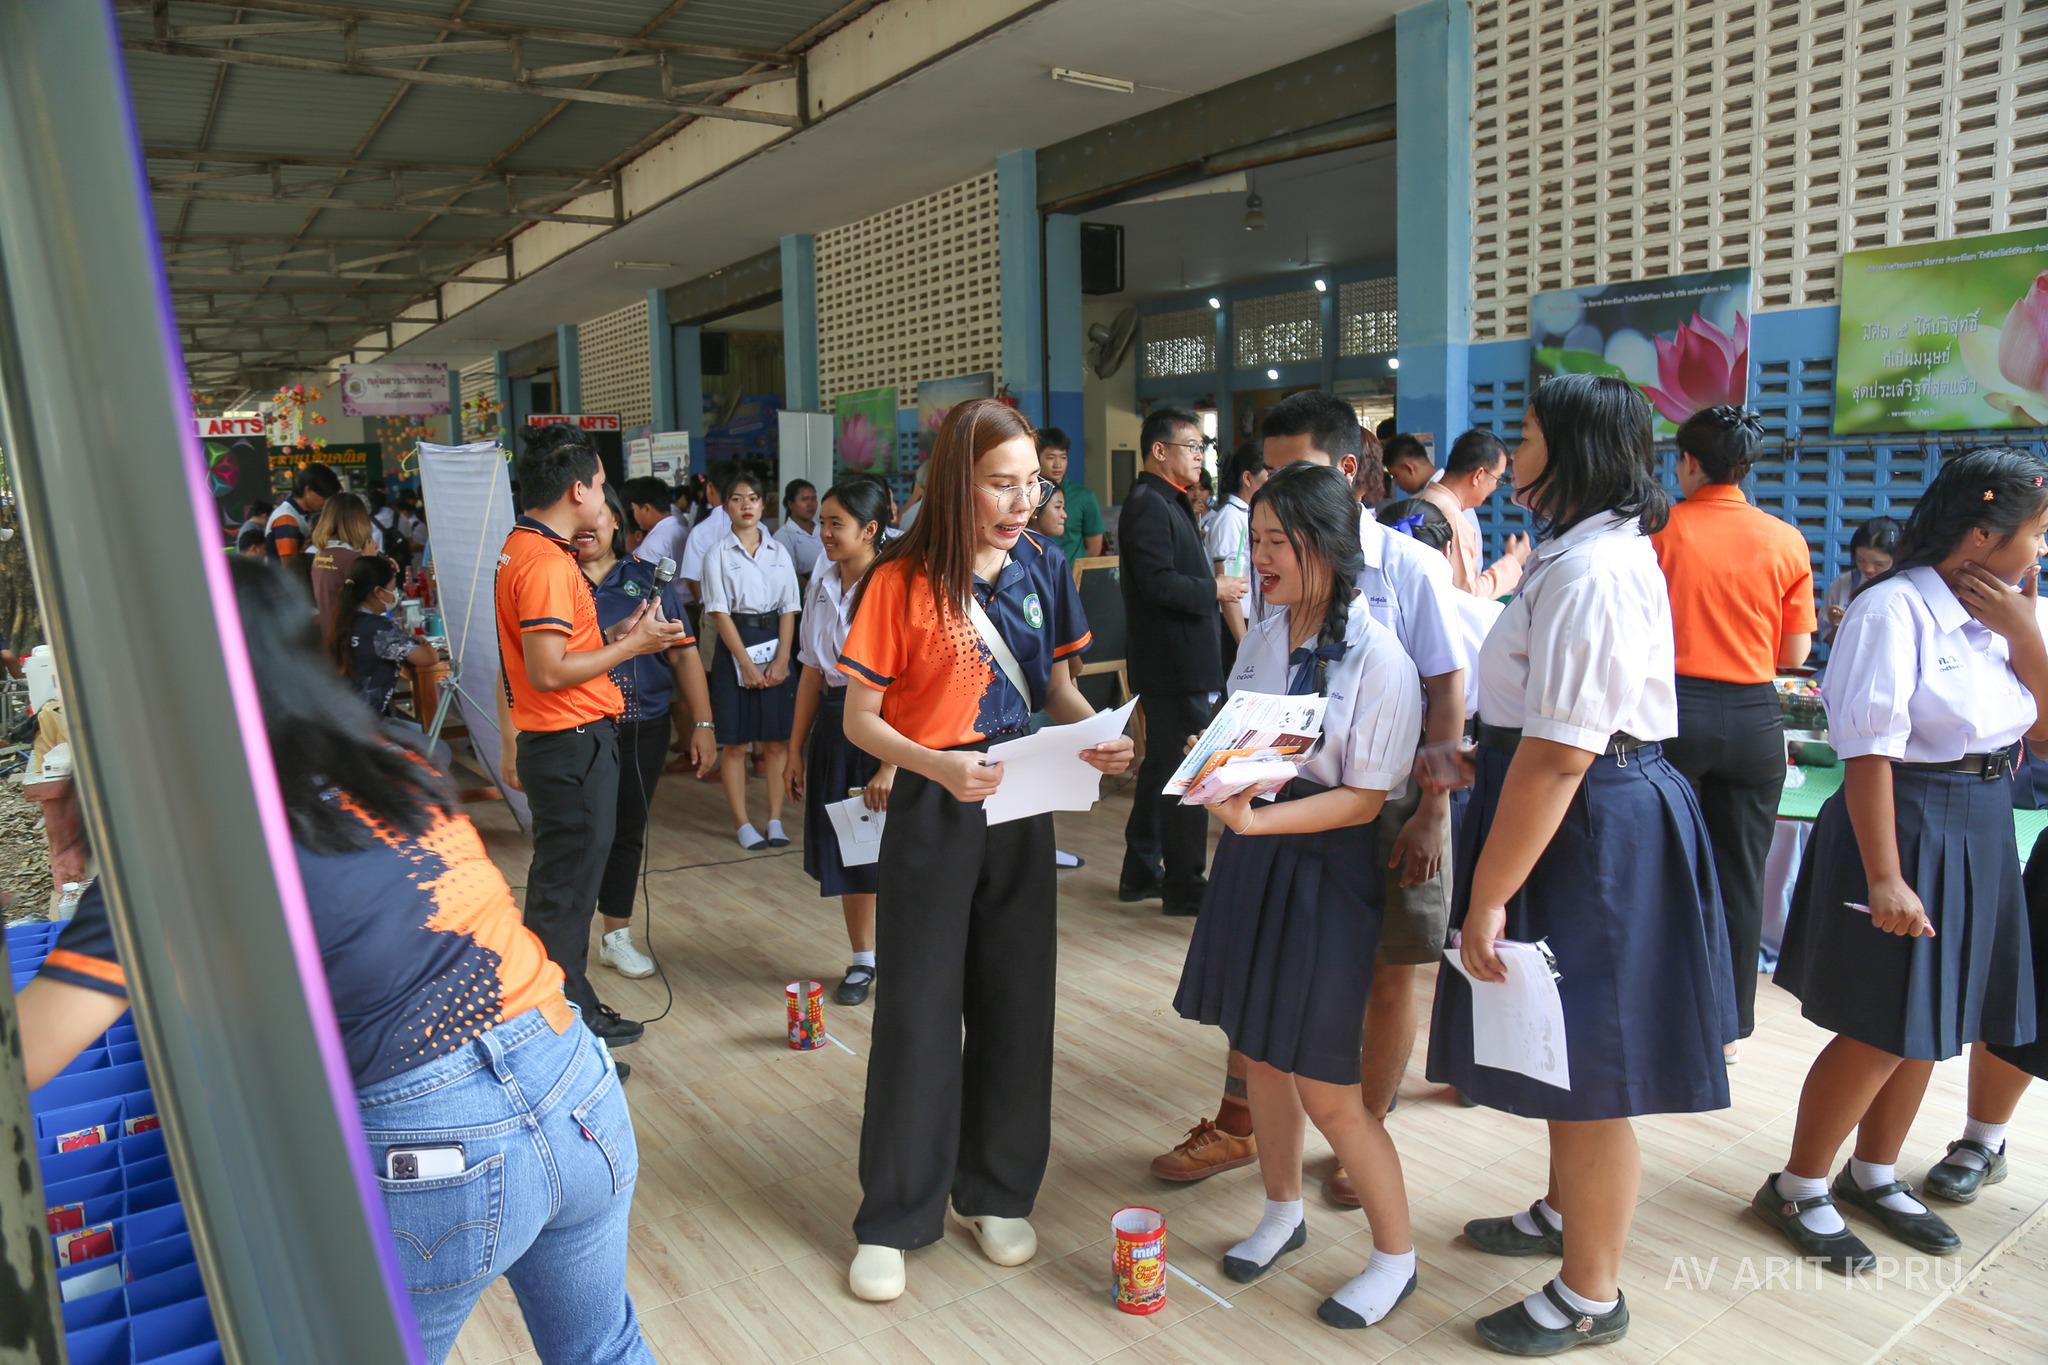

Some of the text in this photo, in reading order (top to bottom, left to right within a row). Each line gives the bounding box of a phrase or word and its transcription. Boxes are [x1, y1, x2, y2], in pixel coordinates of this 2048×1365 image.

[208, 418, 264, 435] ARTS
[579, 416, 618, 430] ARTS
[1132, 1240, 1161, 1259] mini
